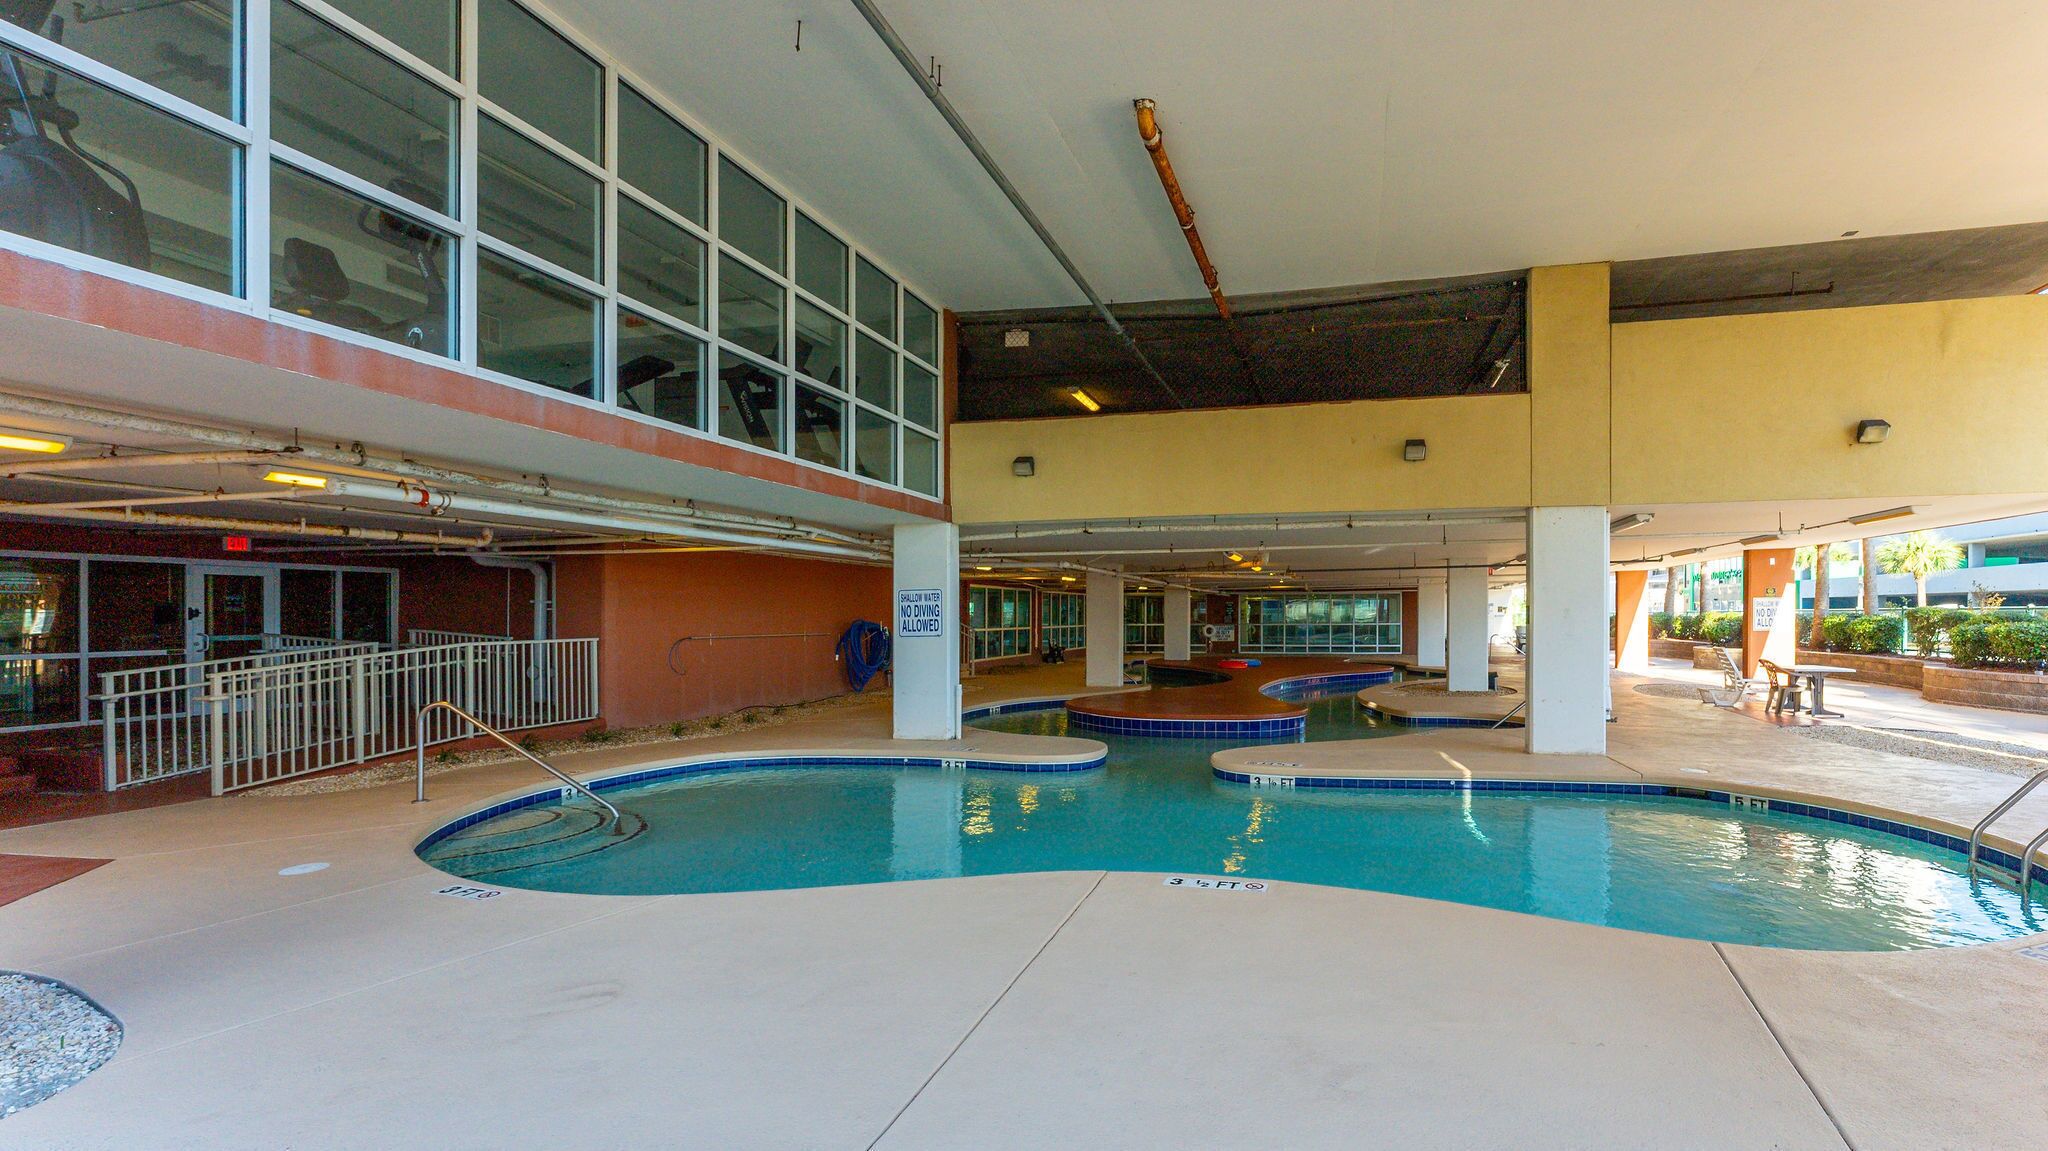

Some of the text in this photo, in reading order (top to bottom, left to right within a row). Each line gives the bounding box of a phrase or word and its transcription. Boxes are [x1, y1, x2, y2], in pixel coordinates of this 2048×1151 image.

[901, 593, 940, 602] SHALLOW WATER
[901, 604, 940, 617] NO DIVING
[1756, 608, 1765, 617] NO
[902, 619, 939, 632] ALLOWED
[1254, 776, 1261, 785] 3
[1281, 778, 1294, 786] FT
[1735, 796, 1767, 808] 5 FT
[1216, 881, 1240, 889] FT
[452, 888, 485, 896] FT
